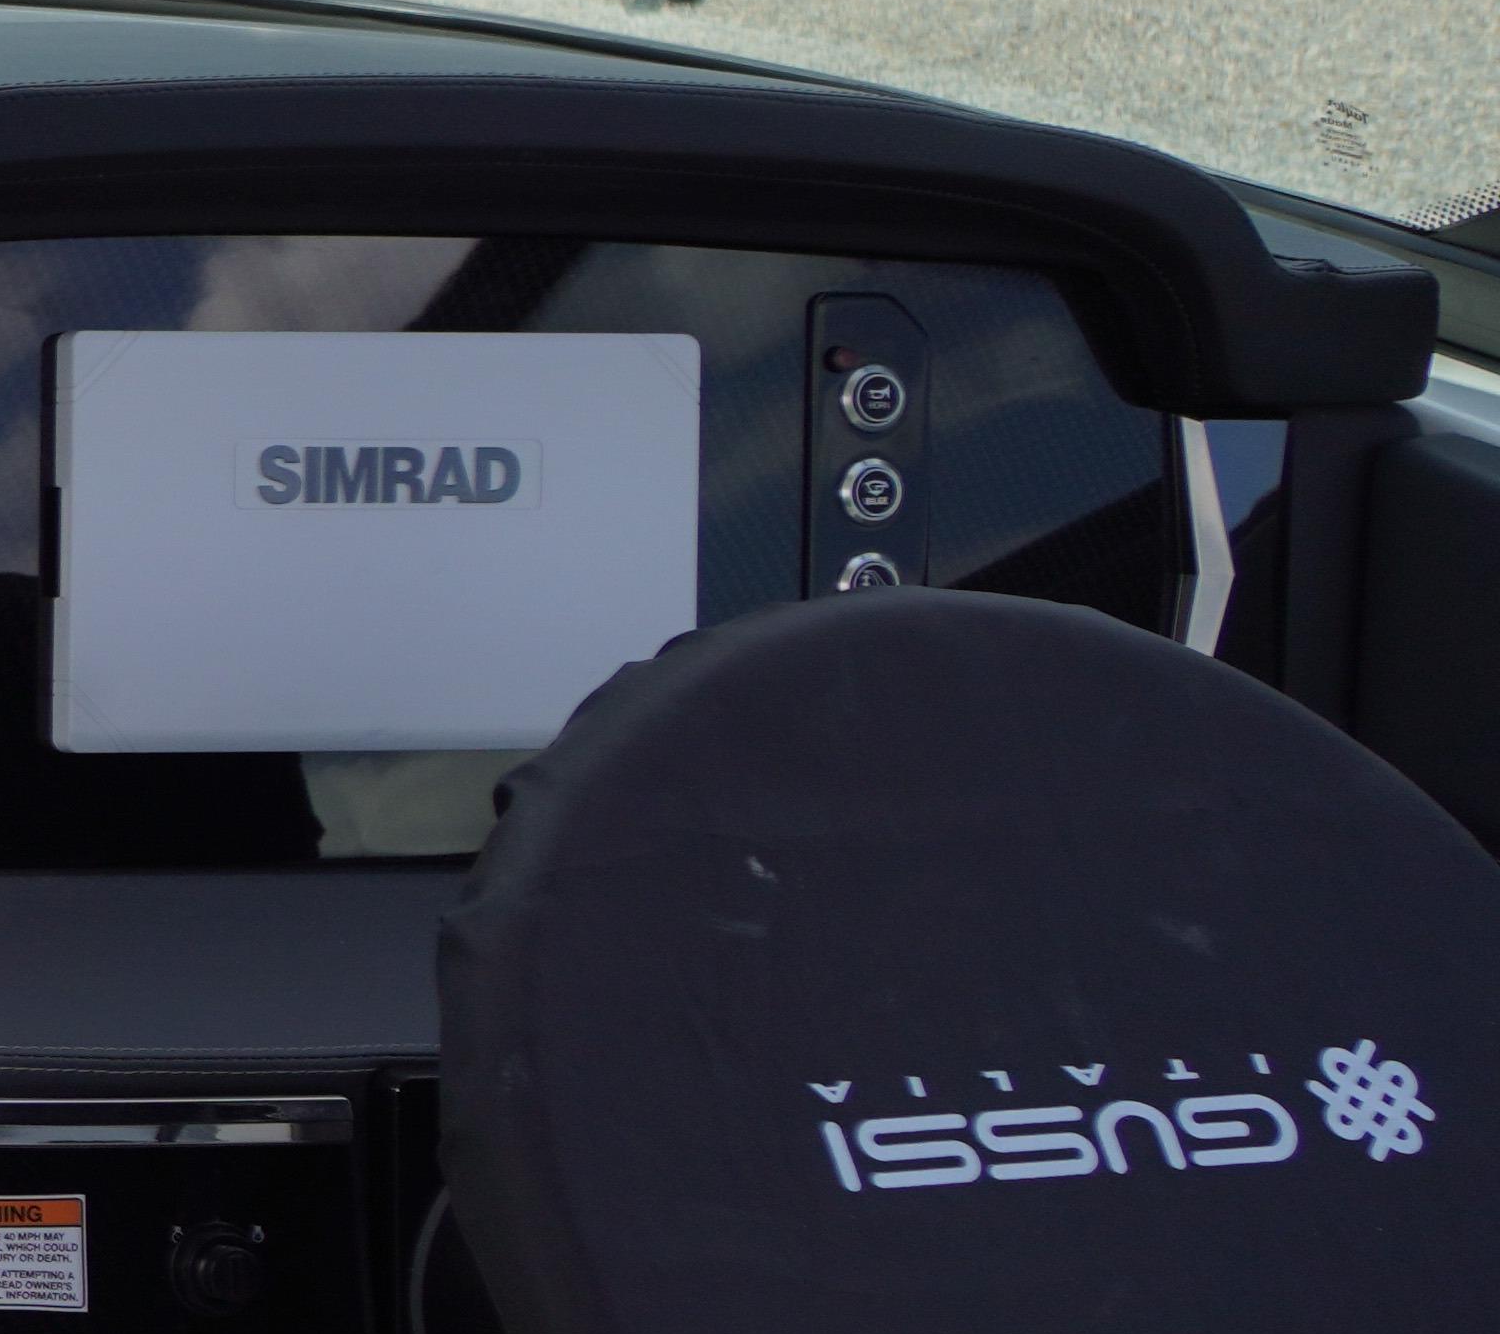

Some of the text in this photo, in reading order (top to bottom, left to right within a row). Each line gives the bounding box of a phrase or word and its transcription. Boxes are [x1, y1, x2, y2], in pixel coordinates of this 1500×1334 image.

[257, 444, 521, 505] SIMRAD
[807, 1052, 1271, 1103] ITALIA
[820, 1093, 1299, 1192] GUSSI
[4, 1232, 14, 1242] 40
[17, 1232, 40, 1242] MPH
[43, 1232, 65, 1242] MAY
[6, 1242, 40, 1252] WHICH
[43, 1242, 78, 1252] COULD
[19, 1253, 33, 1263] OR
[37, 1253, 72, 1263] DEATH.
[1, 1270, 64, 1280] ATTEMPTING
[68, 1270, 74, 1280] A
[25, 1280, 73, 1290] OWNER'S
[6, 1290, 78, 1301] INFORMATION.
